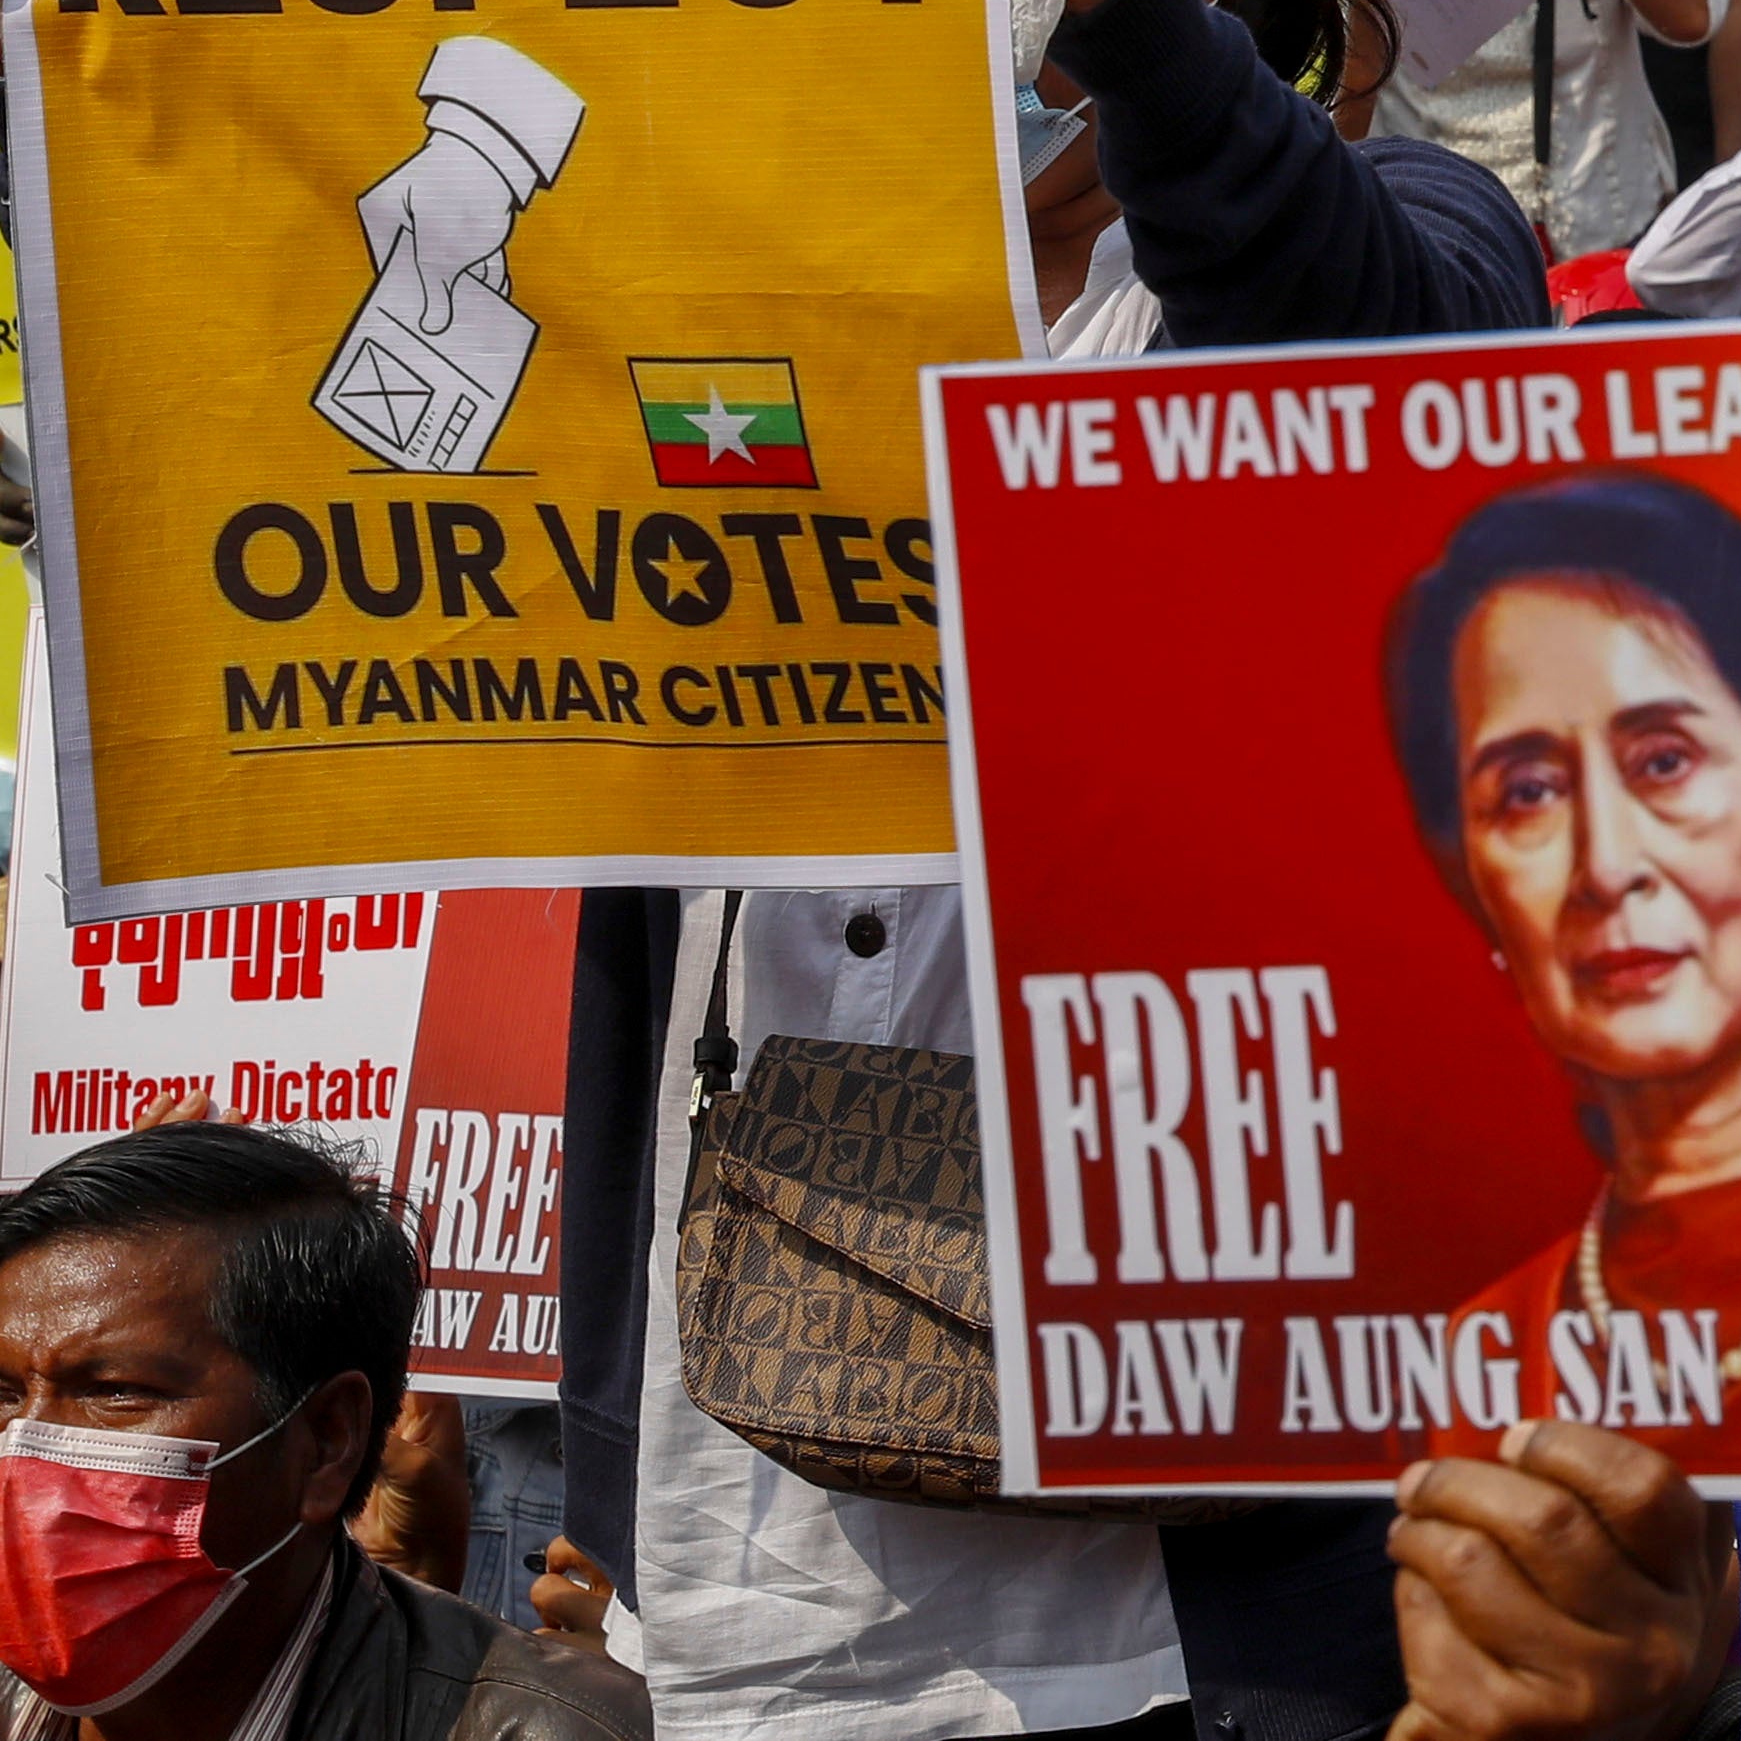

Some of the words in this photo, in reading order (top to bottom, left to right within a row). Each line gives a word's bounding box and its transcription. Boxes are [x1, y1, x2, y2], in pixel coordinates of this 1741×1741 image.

[985, 399, 1121, 491] WE
[1136, 384, 1376, 485] WANT
[1405, 372, 1584, 466] OUR
[213, 501, 518, 623] OUR
[223, 658, 648, 733] MYANMAR
[1019, 964, 1356, 1287] FREE
[414, 1108, 564, 1275] FREE
[1034, 1315, 1245, 1441] DAW
[1277, 1311, 1520, 1436] AUNG
[1546, 1309, 1725, 1429] SAN
